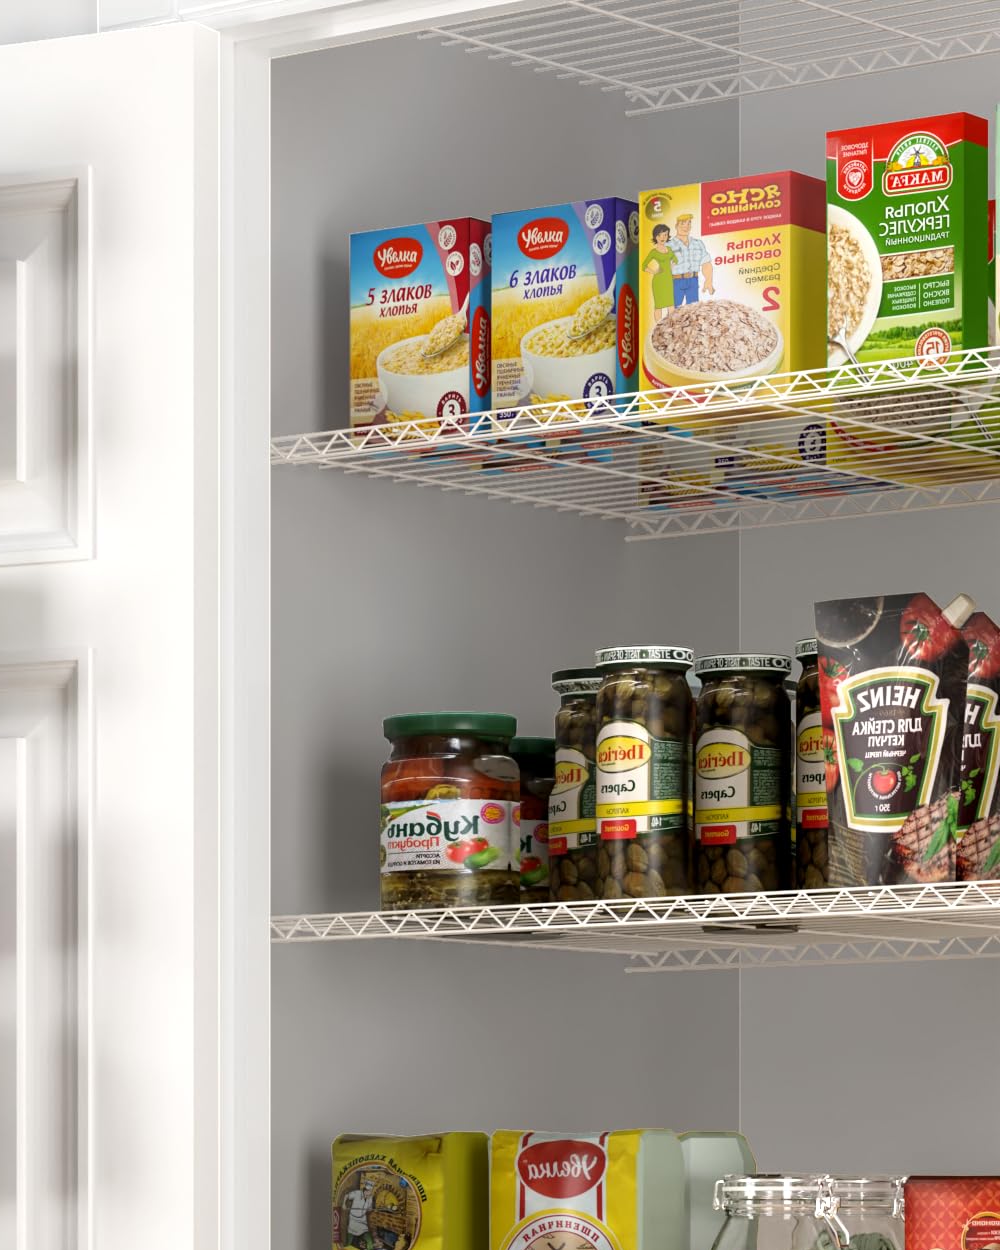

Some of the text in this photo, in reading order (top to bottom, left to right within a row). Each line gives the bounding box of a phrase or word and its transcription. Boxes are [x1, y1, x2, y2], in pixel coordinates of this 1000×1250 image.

[522, 227, 563, 249] Увелка
[377, 246, 418, 266] Увелка
[509, 270, 519, 288] 6
[365, 288, 375, 305] 5
[622, 294, 633, 370] Увелка
[474, 316, 488, 396] Увелка
[648, 650, 671, 659] TASTE
[748, 658, 771, 667] TASTE
